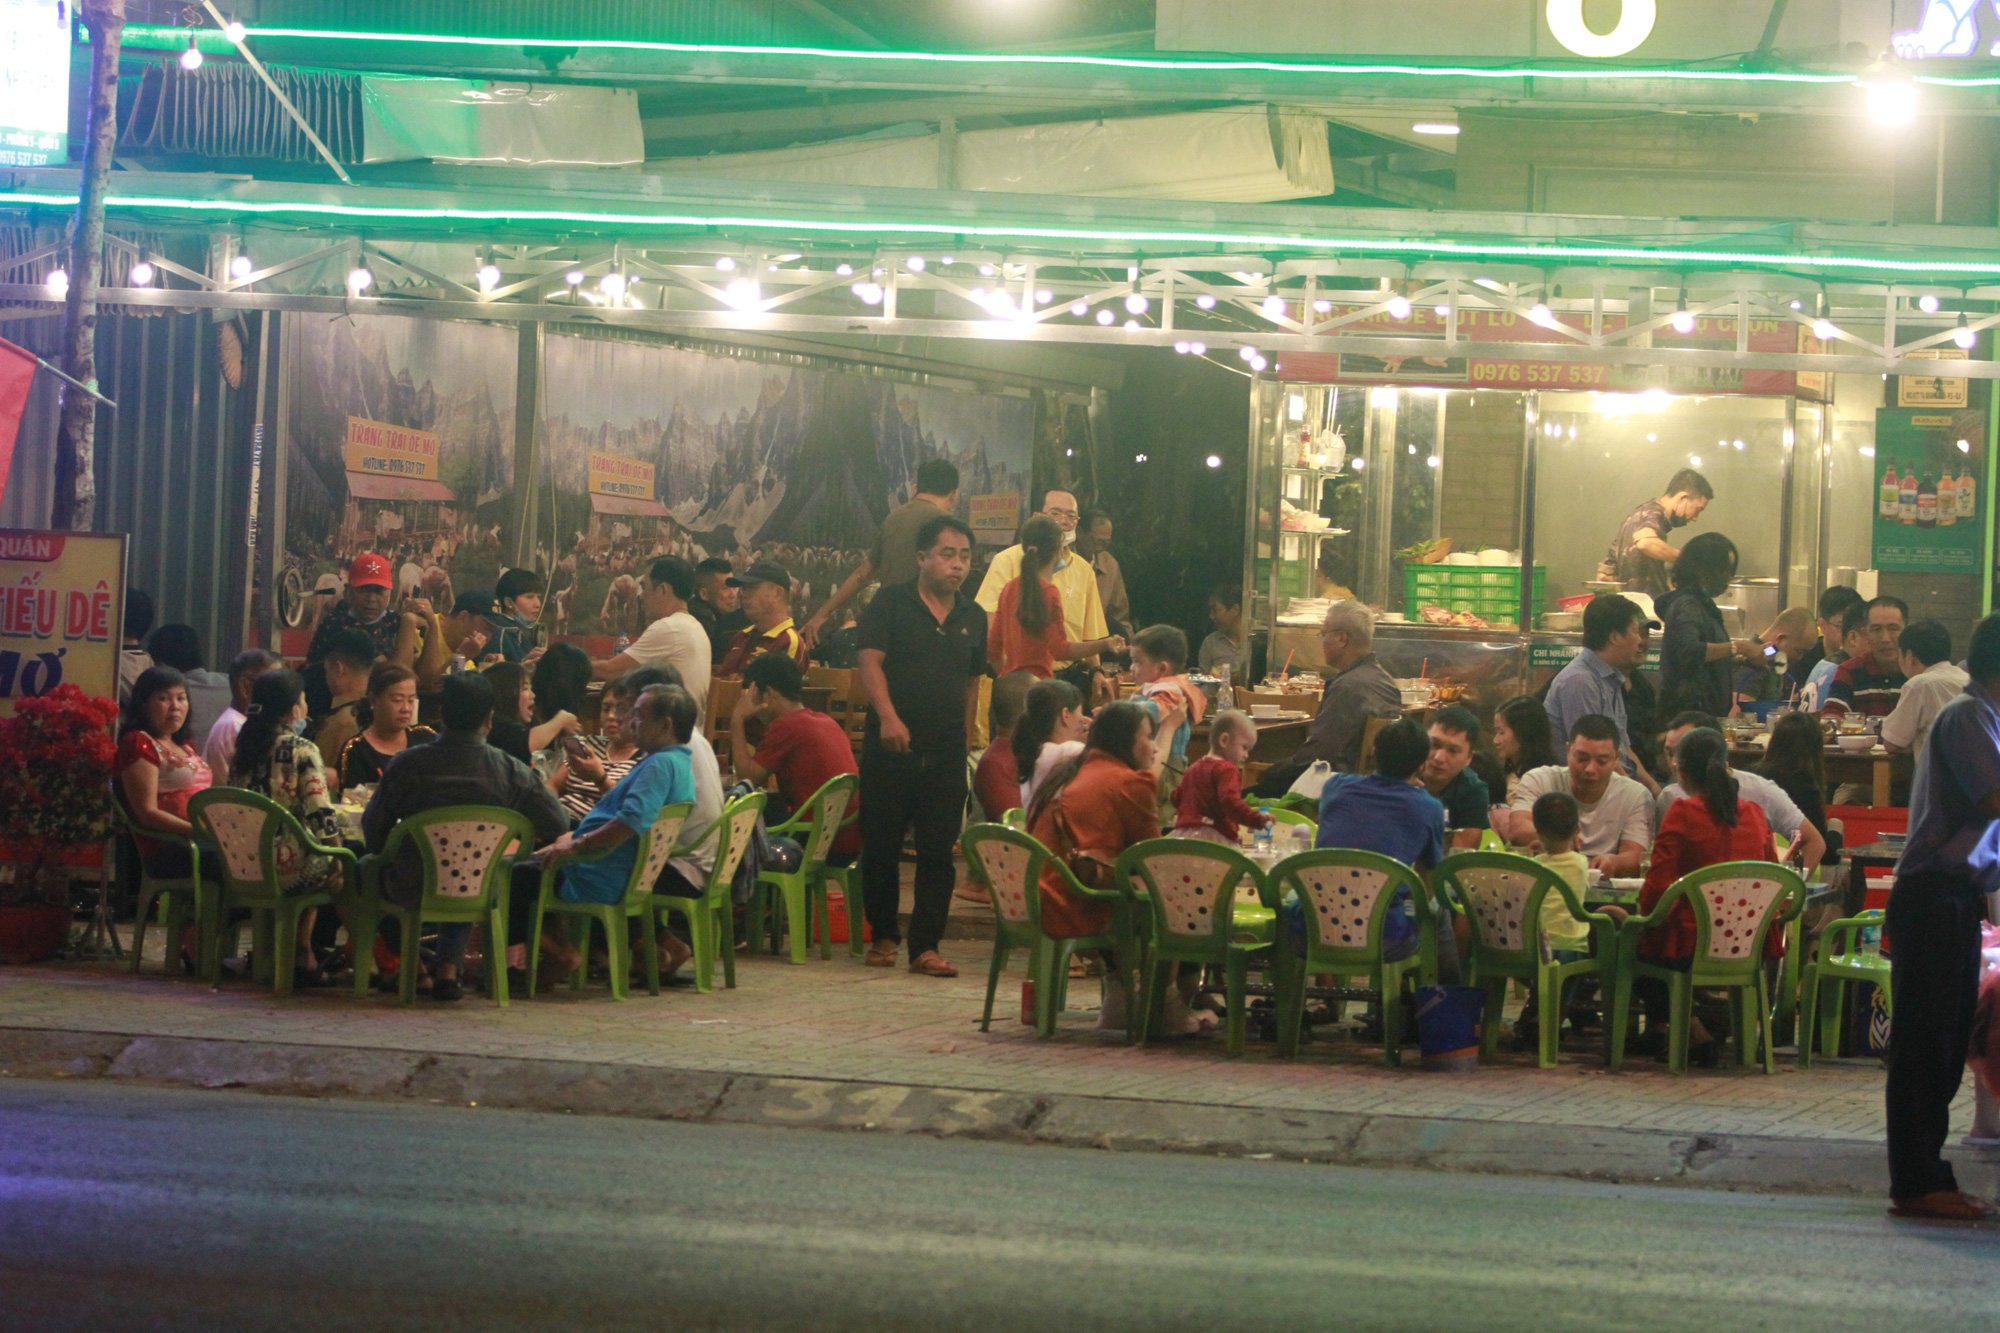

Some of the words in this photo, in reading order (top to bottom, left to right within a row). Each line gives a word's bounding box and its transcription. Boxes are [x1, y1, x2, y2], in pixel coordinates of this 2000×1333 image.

[1473, 363, 1521, 382] 0976
[1527, 364, 1562, 383] 537
[1569, 365, 1604, 384] 537
[351, 422, 384, 449] TRANG
[65, 579, 110, 641] DÊ
[1533, 649, 1548, 657] CHI
